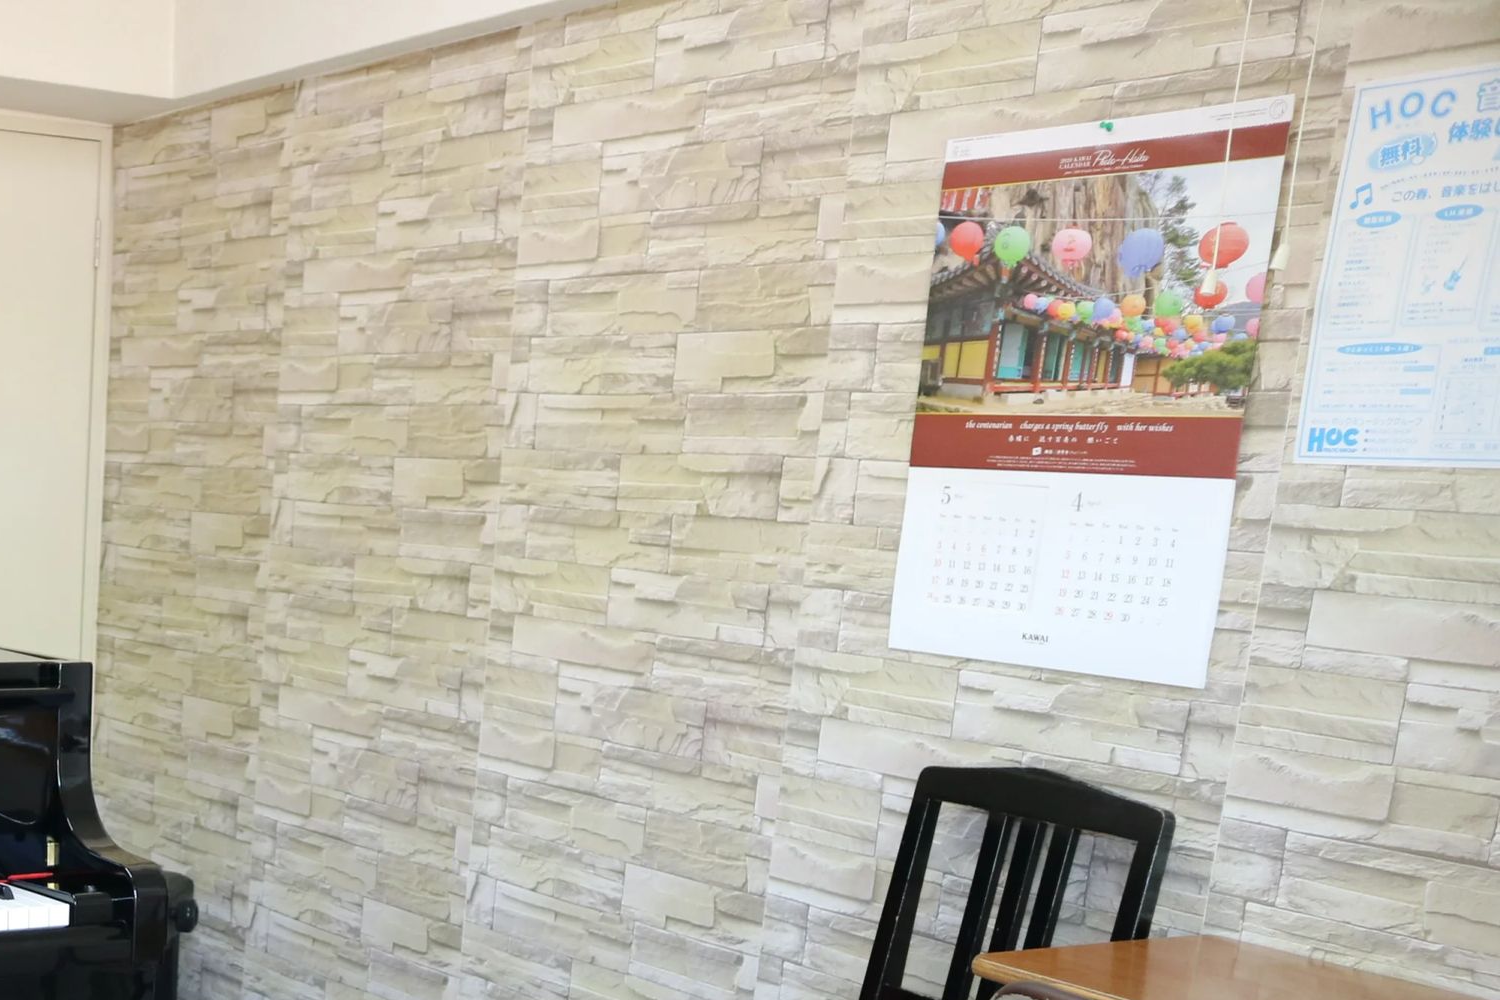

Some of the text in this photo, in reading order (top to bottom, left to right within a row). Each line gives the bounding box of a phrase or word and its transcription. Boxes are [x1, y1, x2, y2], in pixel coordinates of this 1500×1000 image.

[1369, 90, 1457, 130] HOC
[1448, 117, 1500, 143] 体験
[1380, 137, 1421, 166] 無料
[1059, 161, 1092, 169] CALENDAR
[965, 420, 976, 429] the
[976, 421, 1013, 429] centenarian
[1020, 421, 1045, 432] charges
[1051, 421, 1074, 432] spring
[1074, 421, 1109, 433] butterfly
[1116, 422, 1134, 431] with
[1134, 422, 1148, 431] her
[1148, 423, 1174, 432] wishes
[1308, 427, 1360, 452] HOC
[941, 486, 951, 505] 5
[1070, 491, 1083, 512] 4
[1021, 632, 1049, 643] KAWAI
